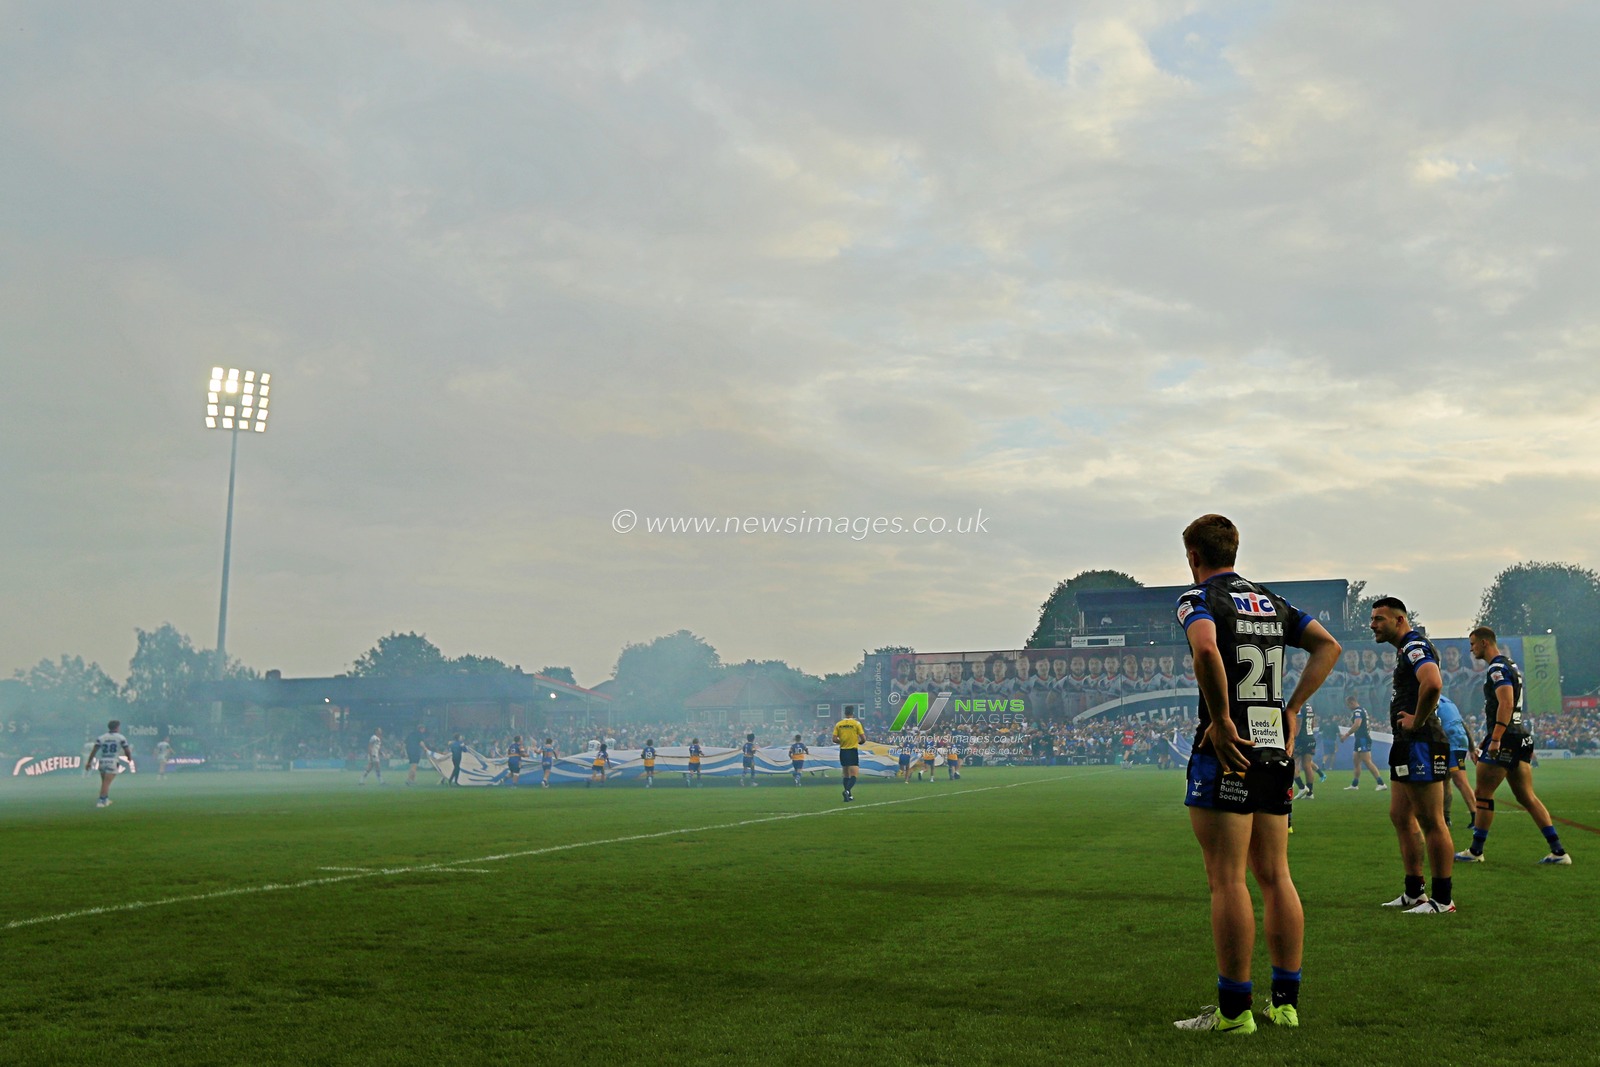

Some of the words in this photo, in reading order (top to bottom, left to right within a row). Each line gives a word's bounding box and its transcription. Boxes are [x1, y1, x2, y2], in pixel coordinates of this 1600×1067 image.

[1236, 619, 1284, 636] EDGELL
[1533, 644, 1552, 680] elite
[1236, 643, 1284, 702] 21
[1250, 720, 1270, 728] Leeds
[128, 725, 158, 736] Toilets
[168, 725, 194, 735] Toilets
[1252, 728, 1278, 737] Bradford
[1254, 737, 1276, 745] Airport
[101, 743, 117, 754] 28
[24, 755, 81, 776] WAKEFIELD
[1221, 778, 1243, 787] Leeds
[1220, 785, 1248, 797] Building
[1219, 792, 1247, 803] Society
